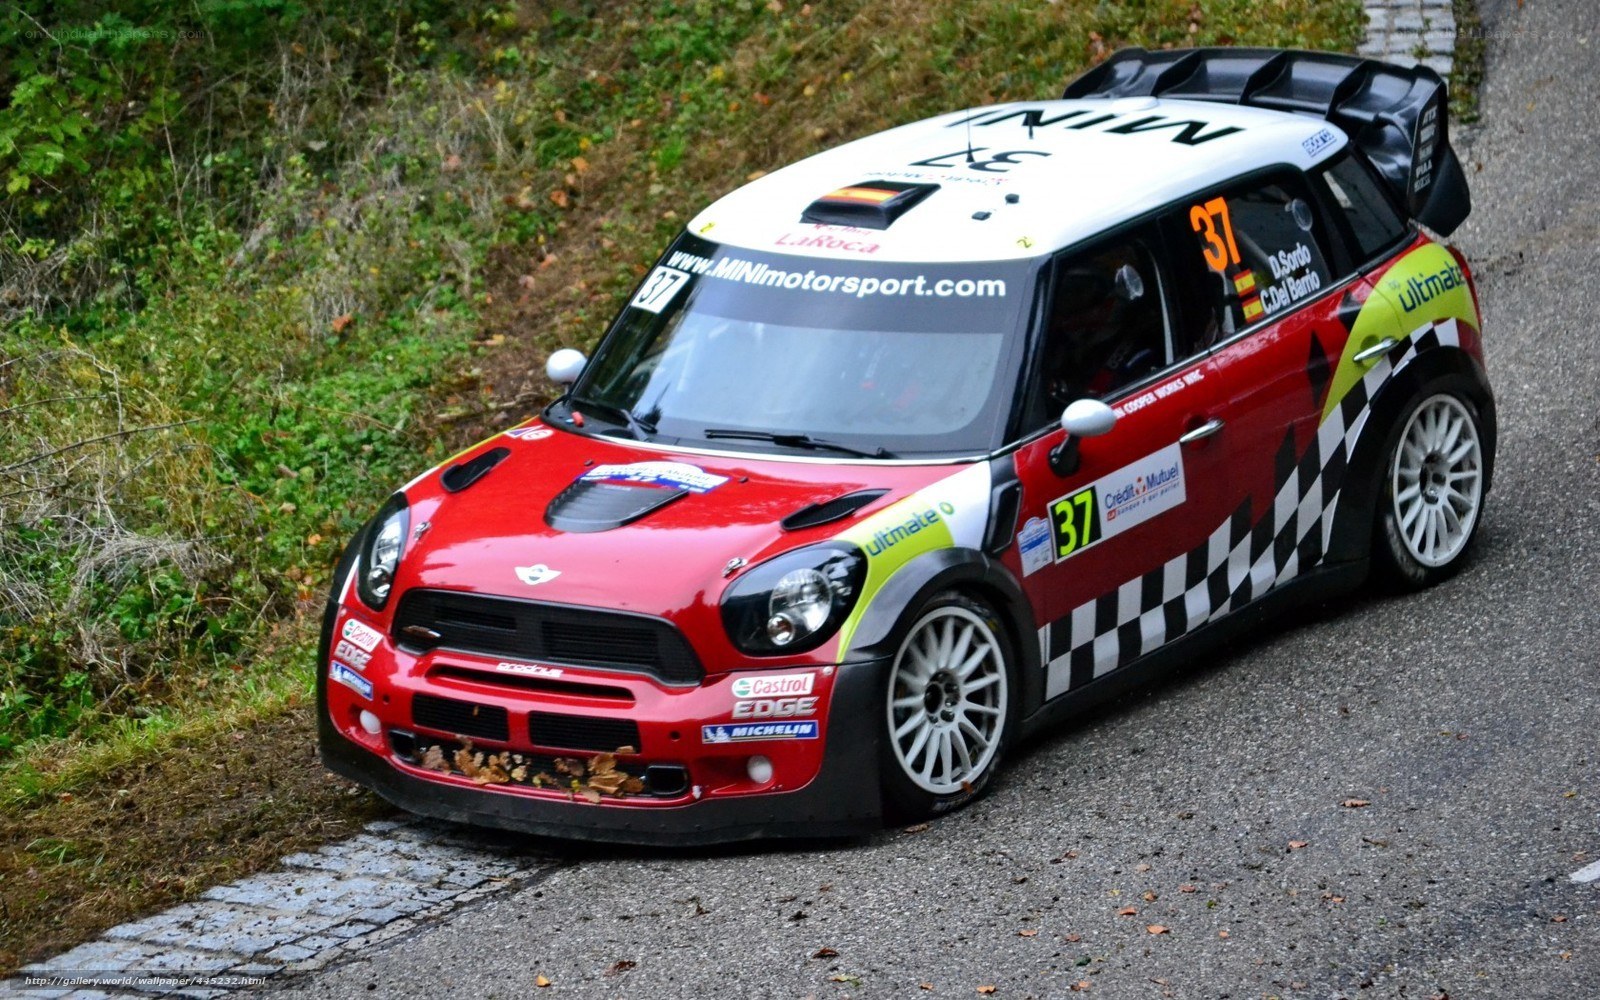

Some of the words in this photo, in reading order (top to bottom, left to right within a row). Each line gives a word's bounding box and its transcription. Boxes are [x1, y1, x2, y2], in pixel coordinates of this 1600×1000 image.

[945, 109, 1246, 146] MINI
[908, 147, 1052, 173] 37
[774, 232, 880, 254] LaRoca
[1189, 196, 1241, 272] 37
[666, 250, 1007, 298] www.MINImotorsport.com
[1268, 242, 1311, 279] D.Sordo
[638, 271, 681, 304] 37
[1105, 483, 1135, 509] Crédit
[1146, 461, 1179, 490] Mutuel
[865, 509, 939, 557] ultimate
[1055, 489, 1093, 557] 37
[333, 639, 373, 671] EDGE
[752, 676, 808, 695] Castrol
[732, 696, 820, 719] EDGE
[731, 724, 813, 737] MICHELIN
